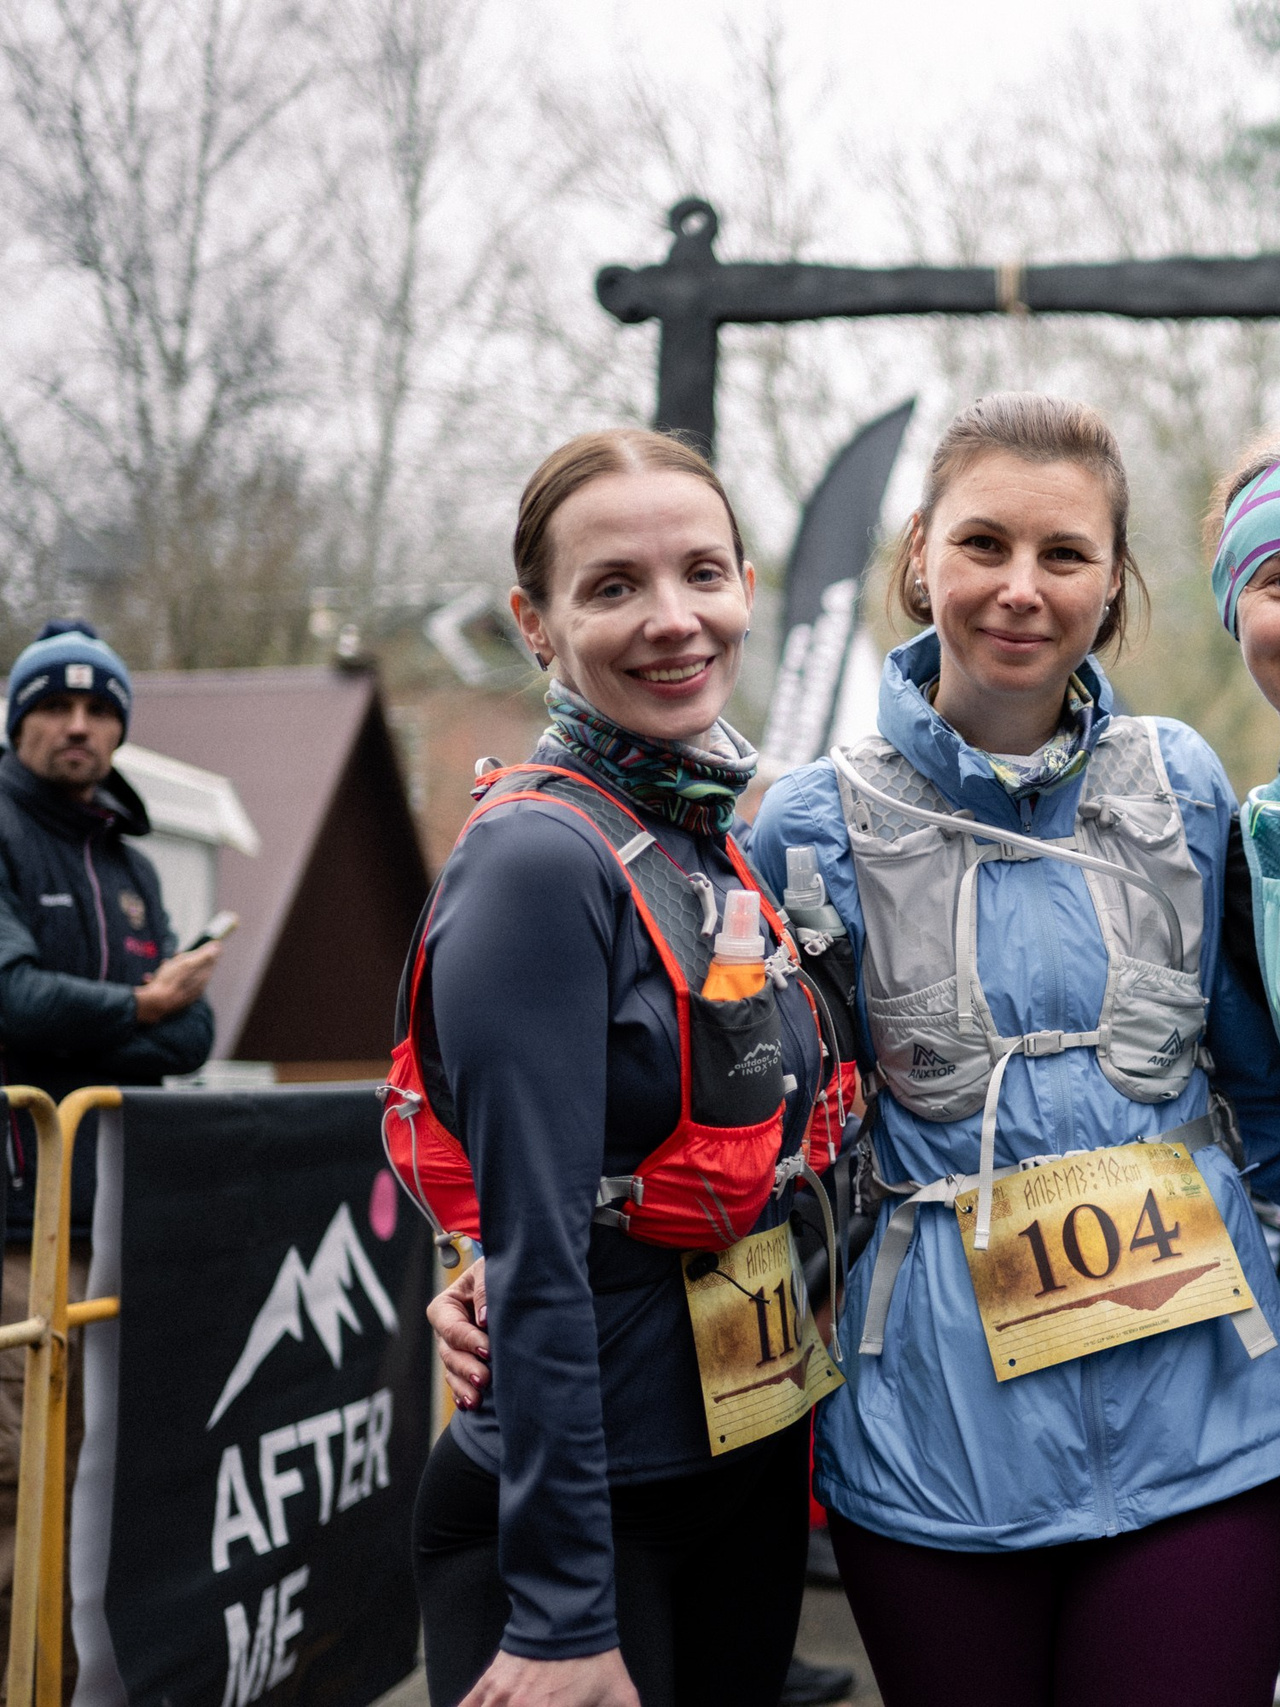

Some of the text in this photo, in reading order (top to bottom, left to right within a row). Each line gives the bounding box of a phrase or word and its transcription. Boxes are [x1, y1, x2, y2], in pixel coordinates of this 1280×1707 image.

[734, 1055, 770, 1070] outdoor
[908, 1063, 956, 1079] ANXTOR
[1019, 1189, 1182, 1297] 104
[213, 1388, 392, 1573] AFTER
[224, 1566, 309, 1707] ME
